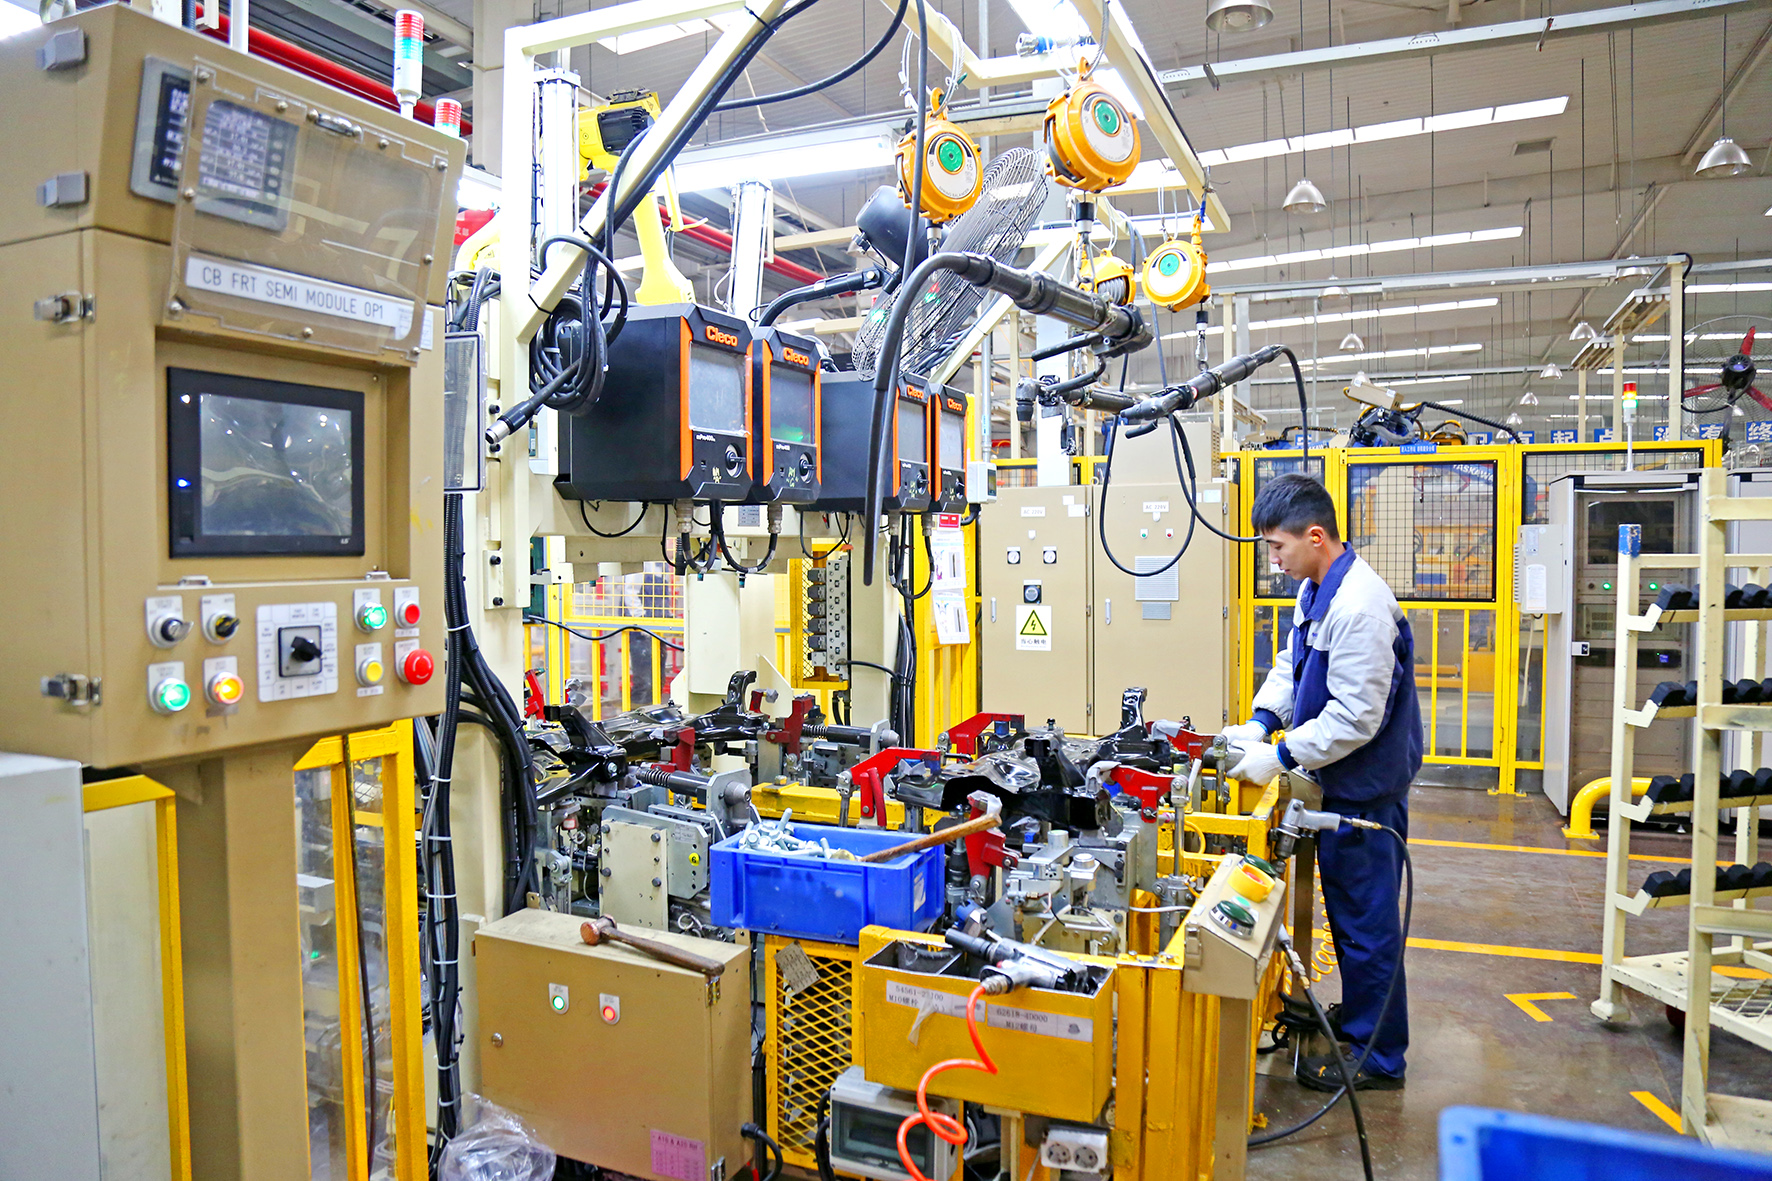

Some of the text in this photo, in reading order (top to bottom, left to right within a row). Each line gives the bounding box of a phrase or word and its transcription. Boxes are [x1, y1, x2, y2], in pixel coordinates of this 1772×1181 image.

[202, 266, 222, 286] CB
[232, 272, 257, 293] FRT
[266, 280, 298, 302] SEMI
[306, 289, 357, 314] MODULE
[364, 302, 384, 319] OP1
[706, 325, 738, 347] Cleco
[783, 347, 810, 366] Cleco
[907, 385, 924, 399] Cleco
[947, 398, 963, 412] Cleco
